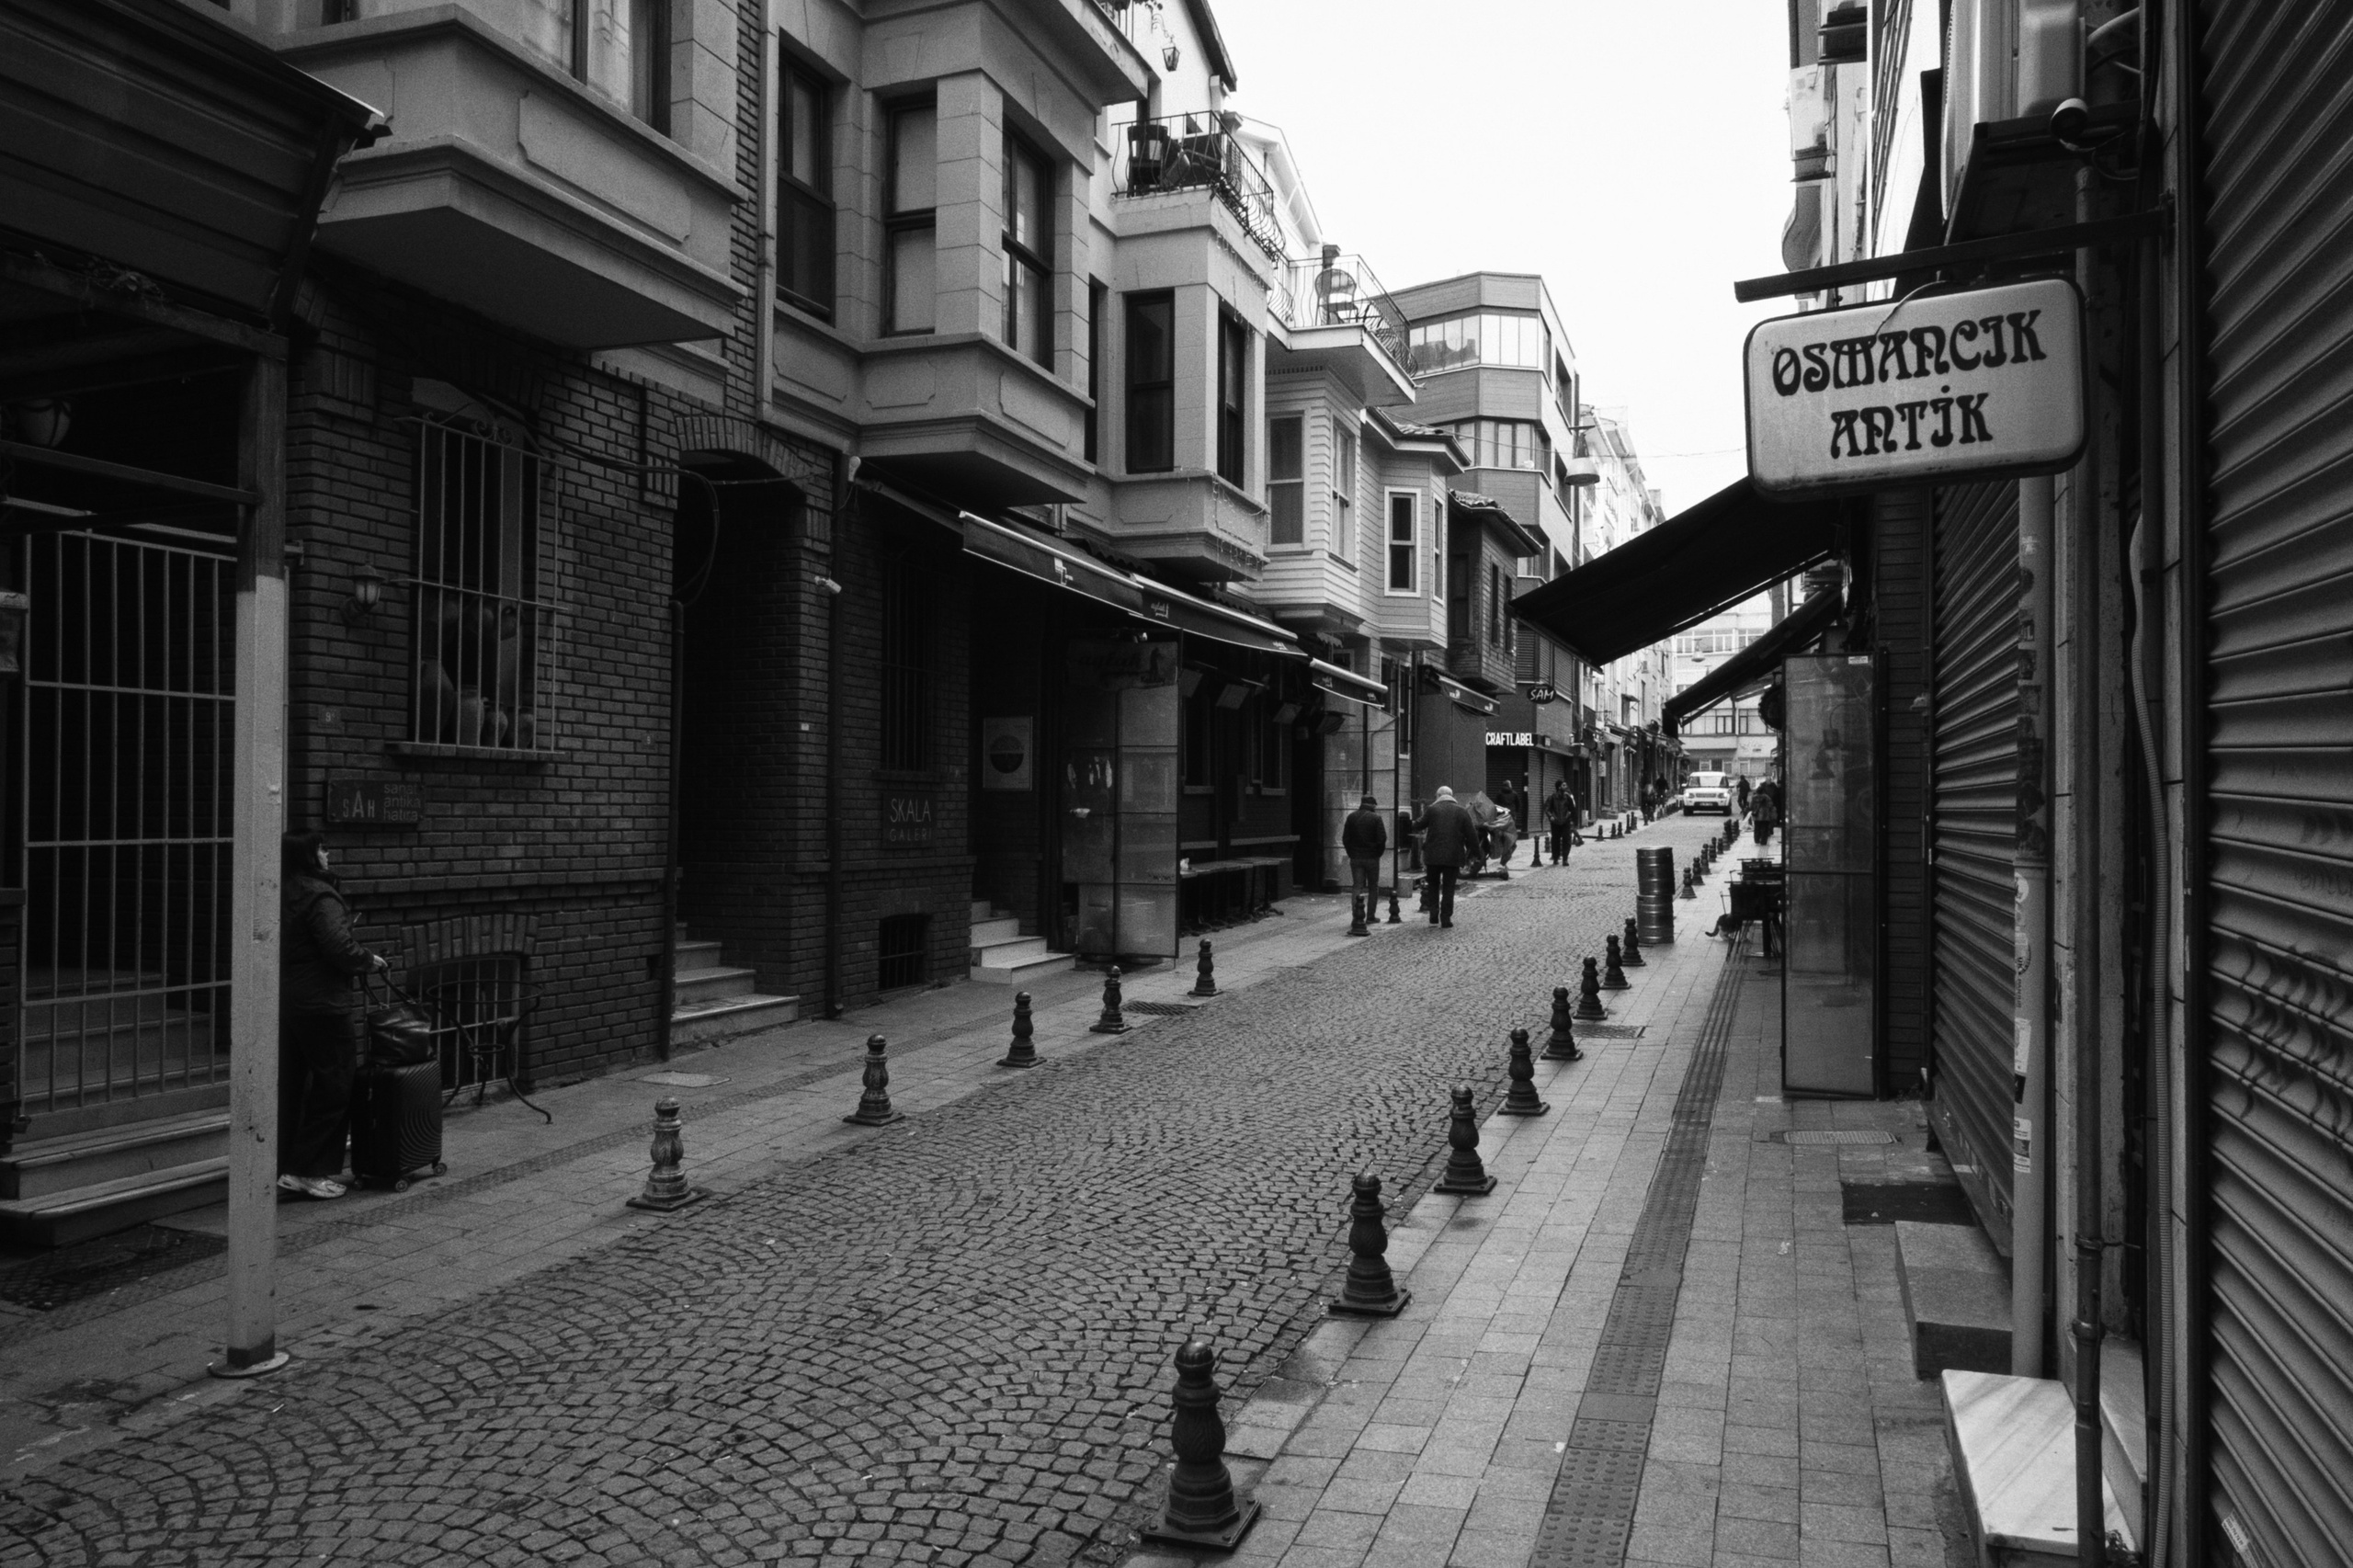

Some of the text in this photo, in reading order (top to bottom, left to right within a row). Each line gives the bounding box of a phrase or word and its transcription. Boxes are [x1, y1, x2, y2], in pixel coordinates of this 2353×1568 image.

[1830, 384, 1994, 459] ANTİK
[1485, 733, 1534, 745] CRAFTLABEL
[383, 783, 418, 795] sanat
[342, 790, 376, 818] SAH
[383, 794, 422, 808] antika
[890, 798, 931, 823] SKALA
